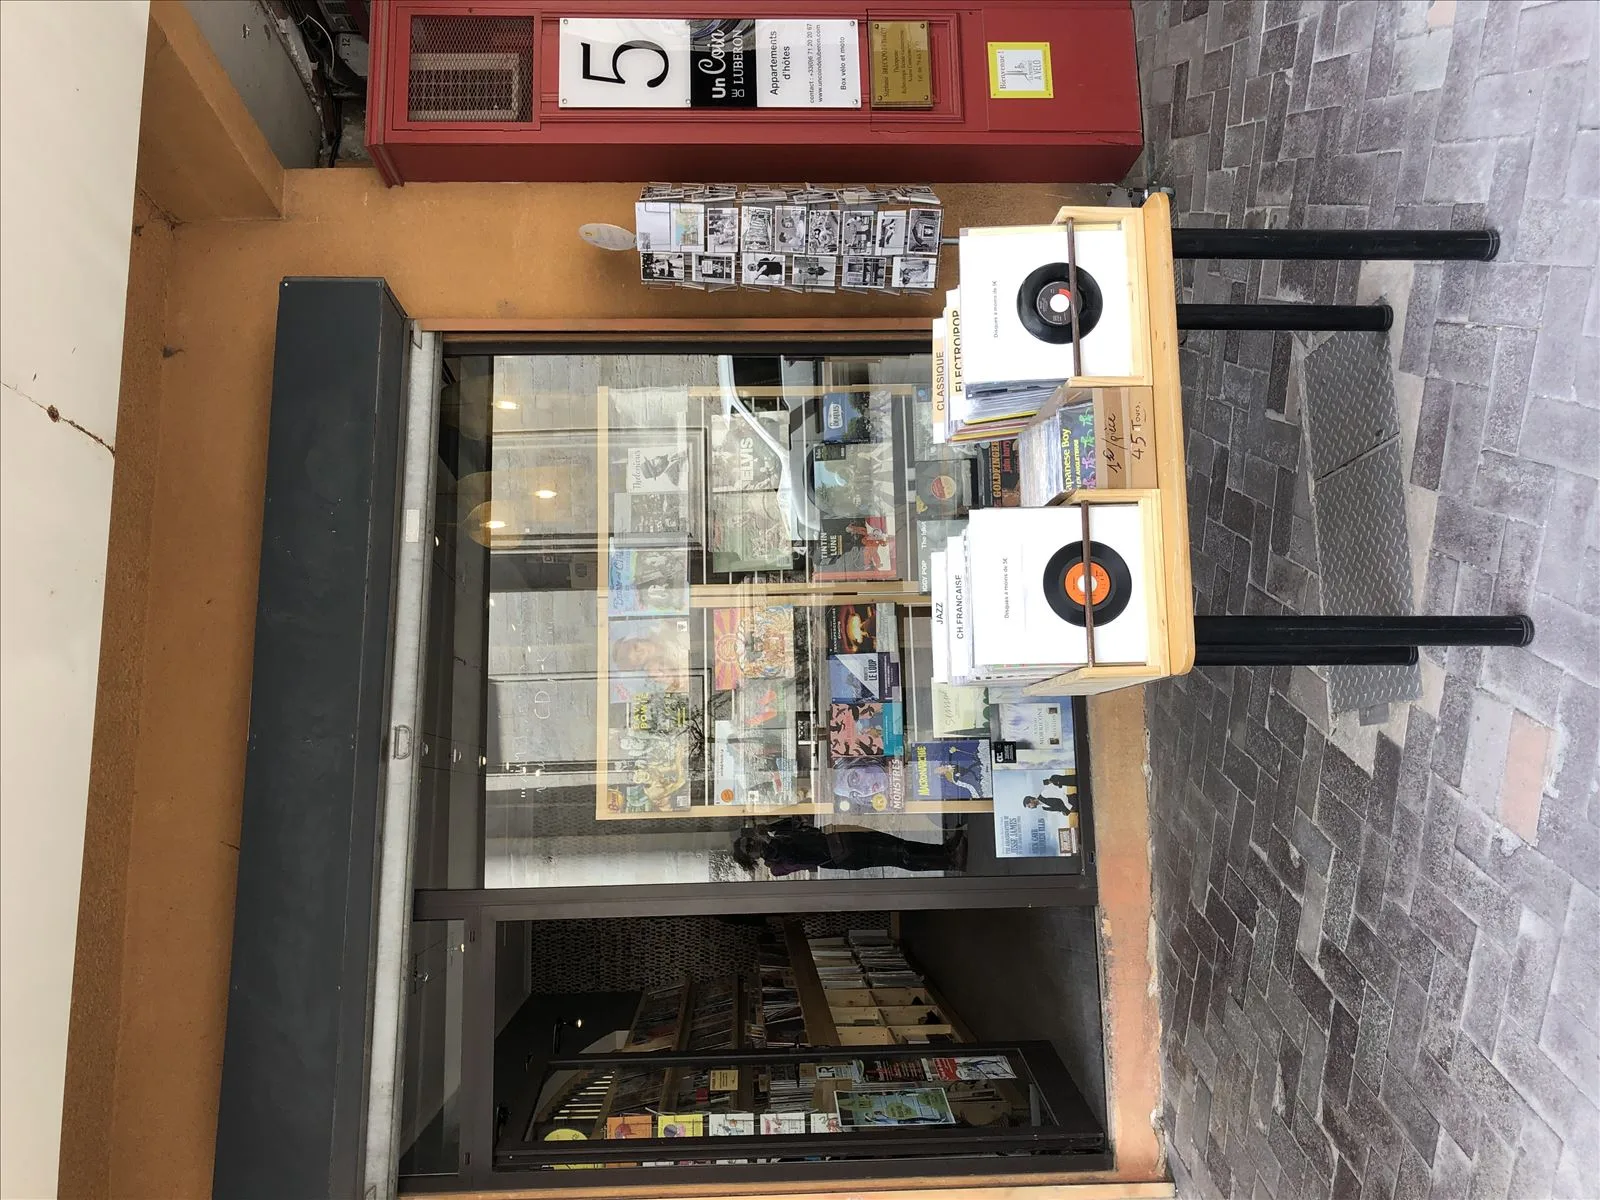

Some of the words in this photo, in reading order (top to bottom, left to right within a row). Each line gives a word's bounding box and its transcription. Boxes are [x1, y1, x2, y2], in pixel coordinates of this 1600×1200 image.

[581, 40, 669, 88] 5
[698, 30, 726, 74] Coin
[732, 30, 744, 84] LUBERON
[769, 30, 780, 95] Appartements
[782, 46, 790, 80] d'hôtes
[712, 78, 726, 98] Un
[952, 310, 962, 392] ELECTRO/POP
[936, 352, 944, 411] CLASSIQUE
[1062, 428, 1071, 447] Boy
[1130, 434, 1146, 459] 45
[740, 438, 754, 480] ELVIS
[991, 442, 1001, 497] GOLDFINGER
[1063, 448, 1074, 490] apanese
[820, 532, 828, 558] TINTIN
[936, 602, 944, 624] JAZZ
[955, 574, 964, 639] CH.FRANCAISE
[868, 659, 877, 673] LOUP
[640, 692, 648, 728] BOWIE
[892, 759, 902, 808] MONSTRES
